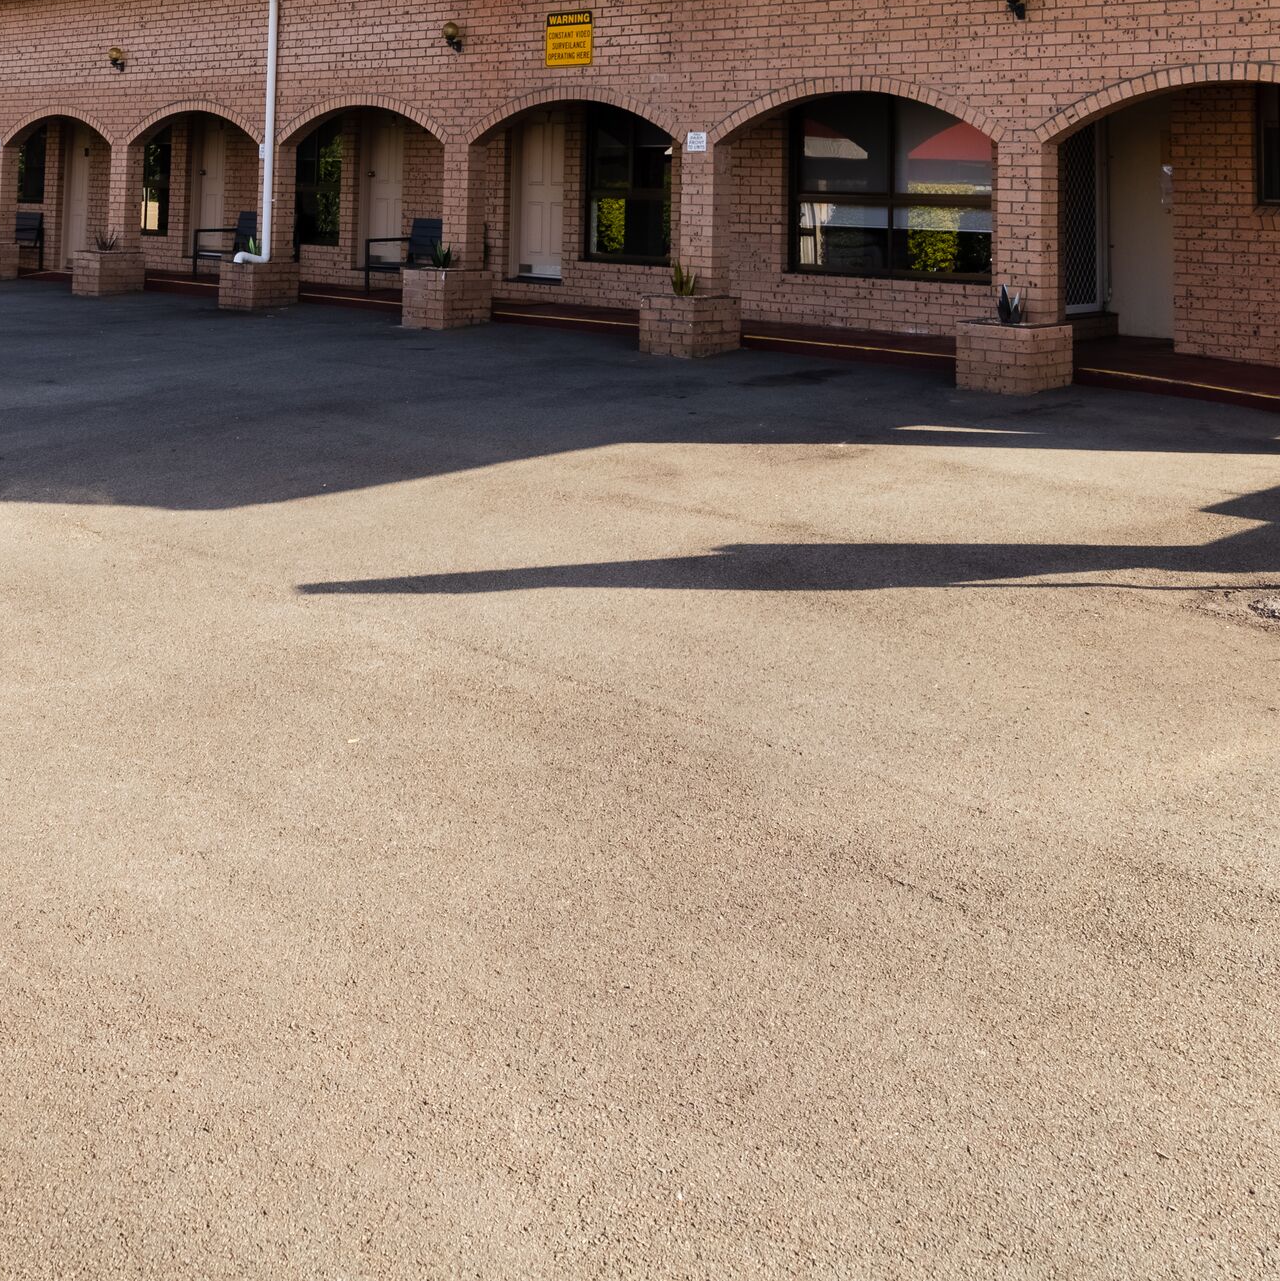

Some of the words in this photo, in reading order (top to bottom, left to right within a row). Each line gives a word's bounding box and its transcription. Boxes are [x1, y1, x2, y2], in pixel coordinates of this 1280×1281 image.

[549, 13, 590, 25] WARNING
[549, 31, 574, 40] CONSTANT
[575, 30, 590, 39] VIDEO
[548, 51, 575, 61] OPERATING
[576, 51, 590, 59] HERE
